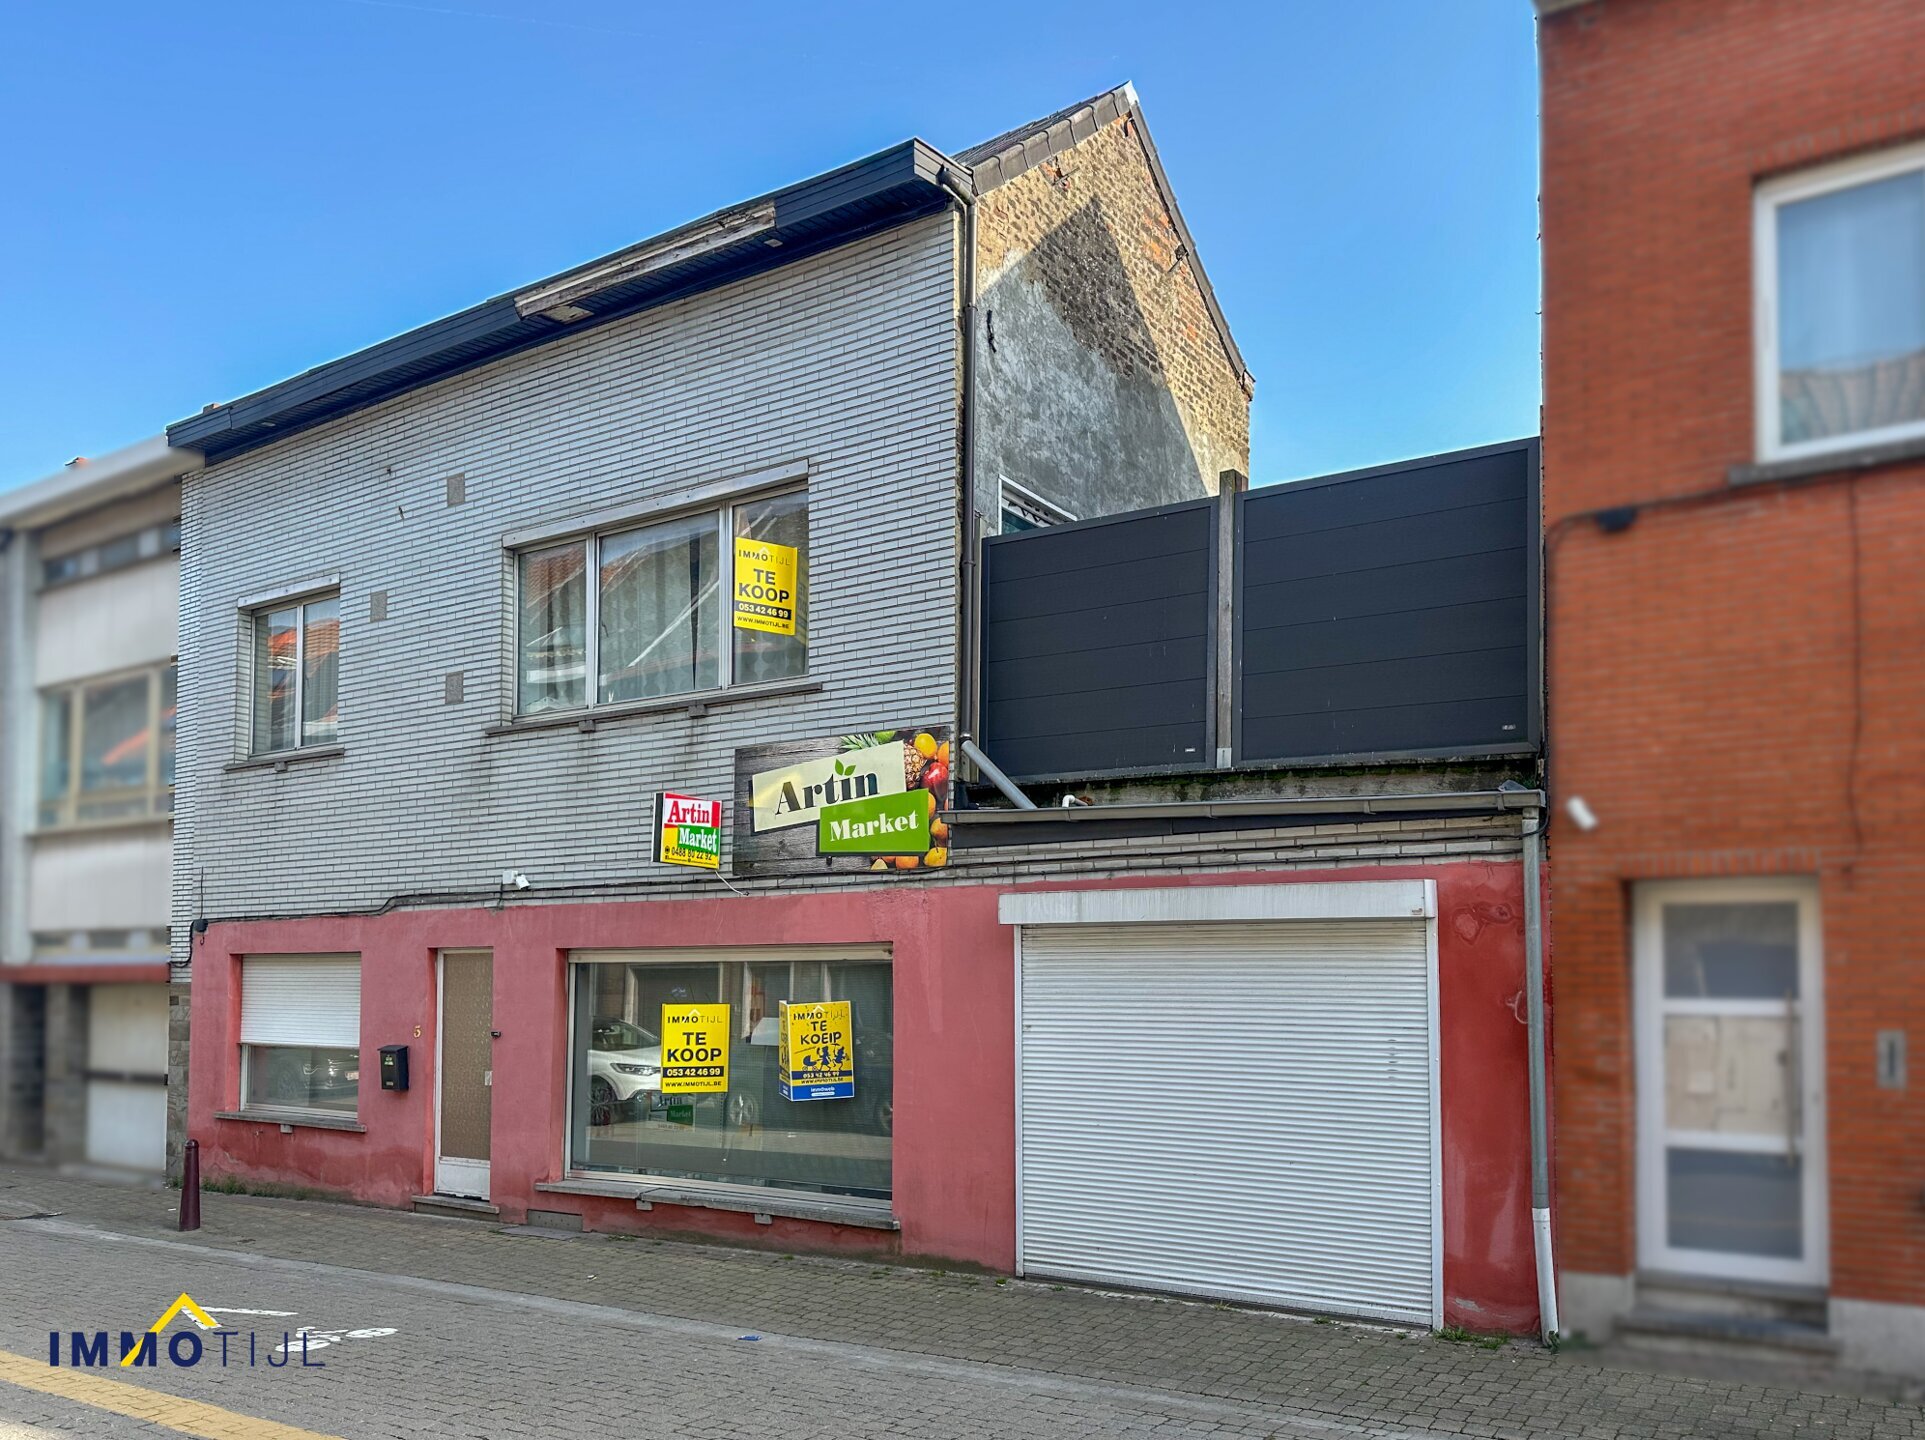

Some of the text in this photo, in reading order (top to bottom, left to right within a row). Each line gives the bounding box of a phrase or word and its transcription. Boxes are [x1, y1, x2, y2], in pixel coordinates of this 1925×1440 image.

[753, 568, 776, 585] TE
[738, 582, 790, 603] KOOP
[738, 602, 789, 618] 053 42 46 99
[775, 772, 880, 816] Artin
[667, 800, 710, 824] Artin
[830, 809, 919, 842] Market
[678, 827, 718, 854] Market
[413, 1024, 421, 1038] 5
[810, 1020, 828, 1032] TE
[682, 1032, 707, 1046] TE
[800, 1031, 842, 1045] KOEIP
[667, 1048, 722, 1062] KOOP
[666, 1067, 721, 1077] 053 42 46 99
